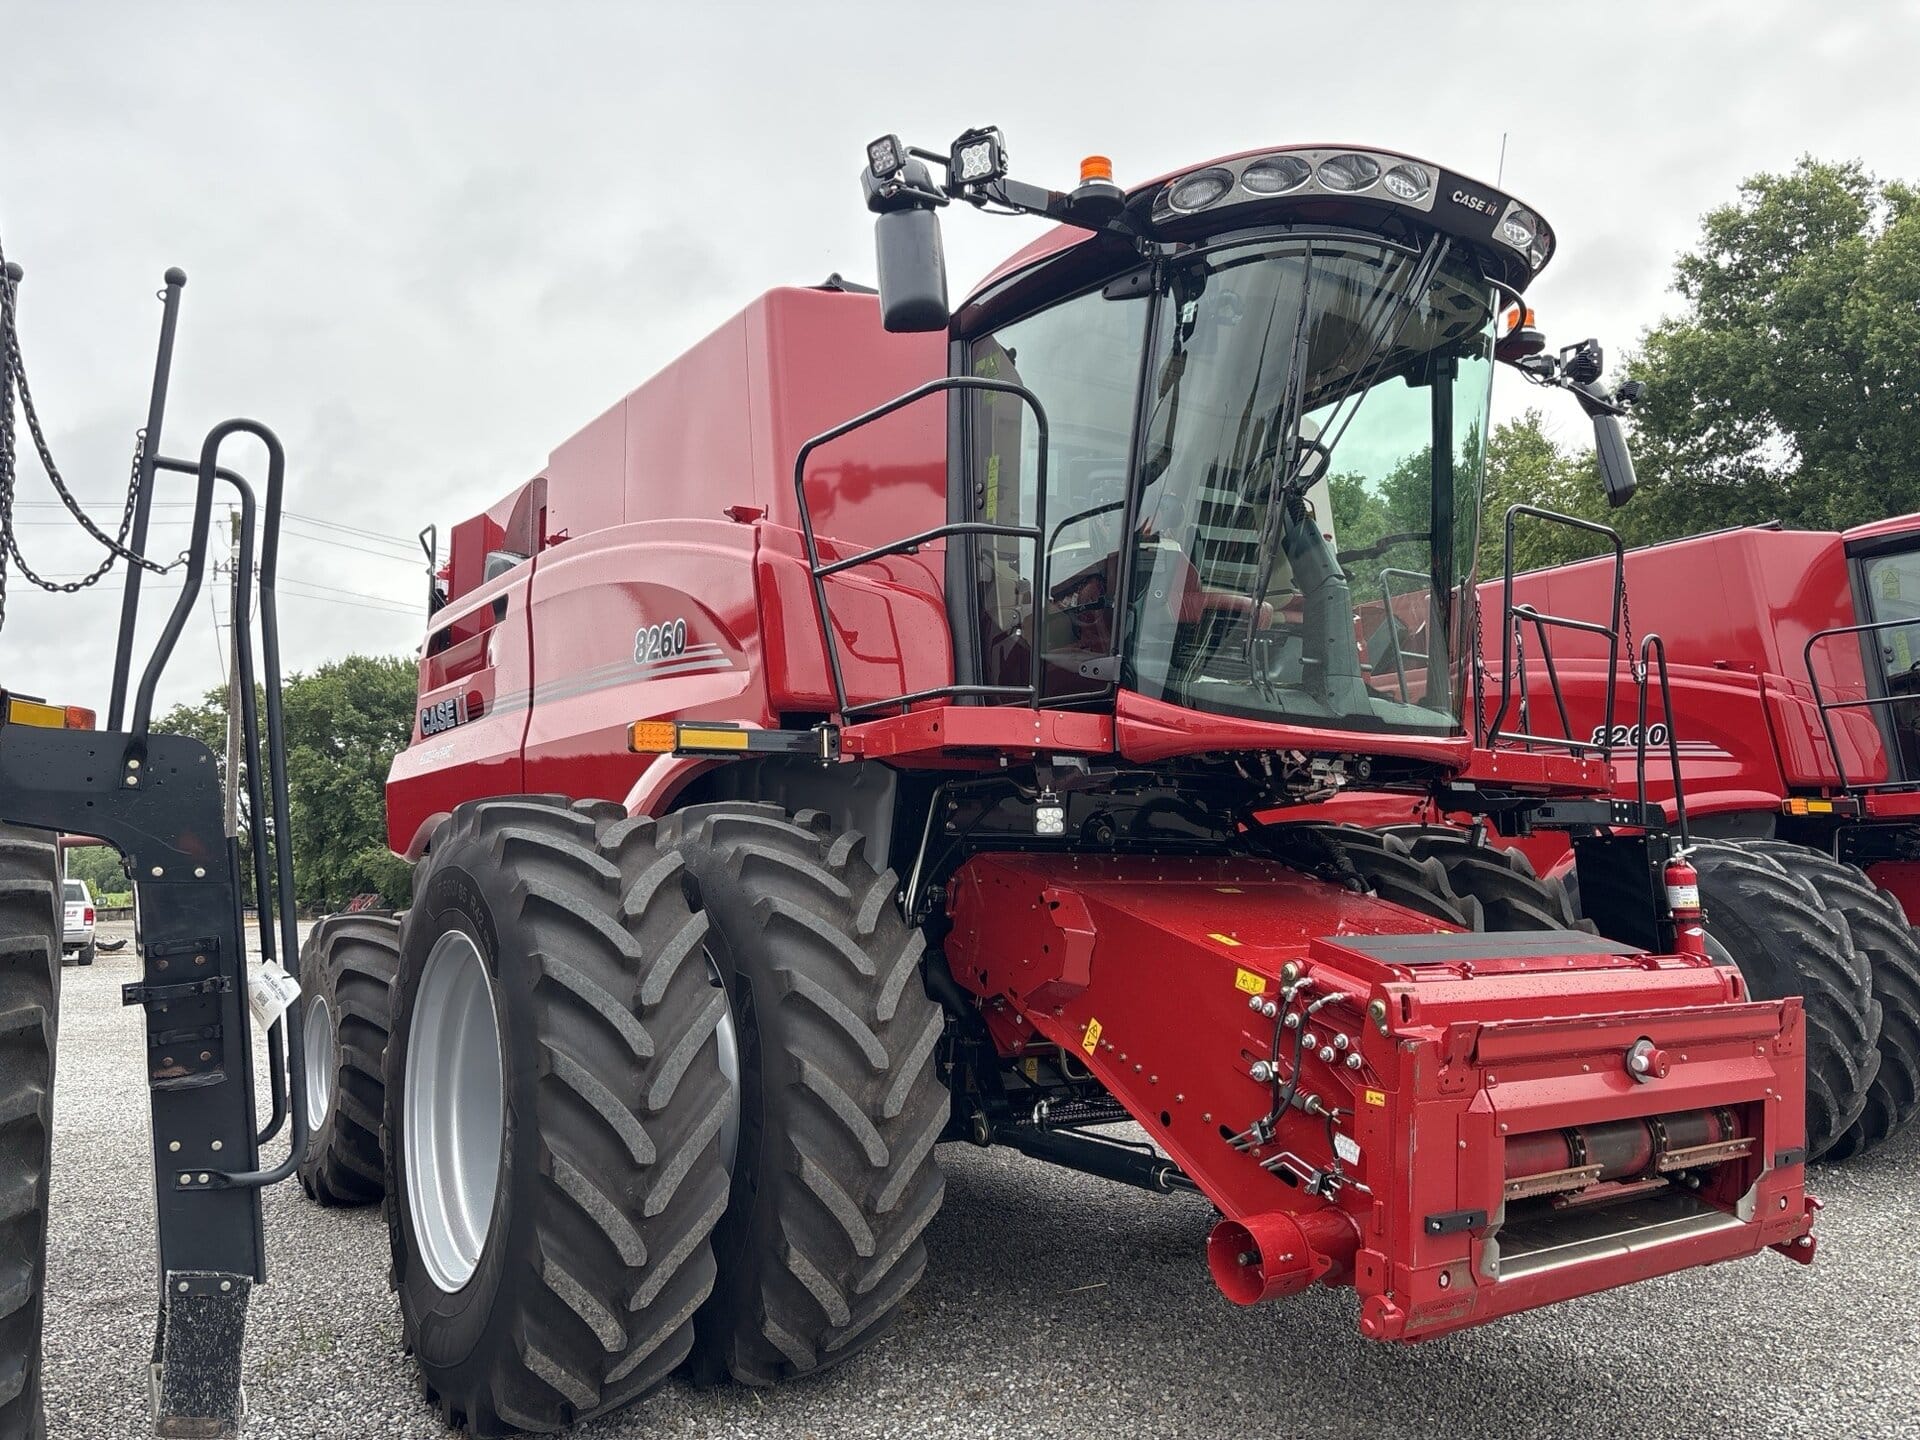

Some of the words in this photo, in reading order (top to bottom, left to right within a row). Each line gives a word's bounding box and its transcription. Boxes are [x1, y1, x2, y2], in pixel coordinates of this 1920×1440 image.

[1452, 190, 1486, 212] CASE
[634, 617, 687, 664] 8260
[421, 699, 456, 735] CASE
[1591, 723, 1667, 747] 8260
